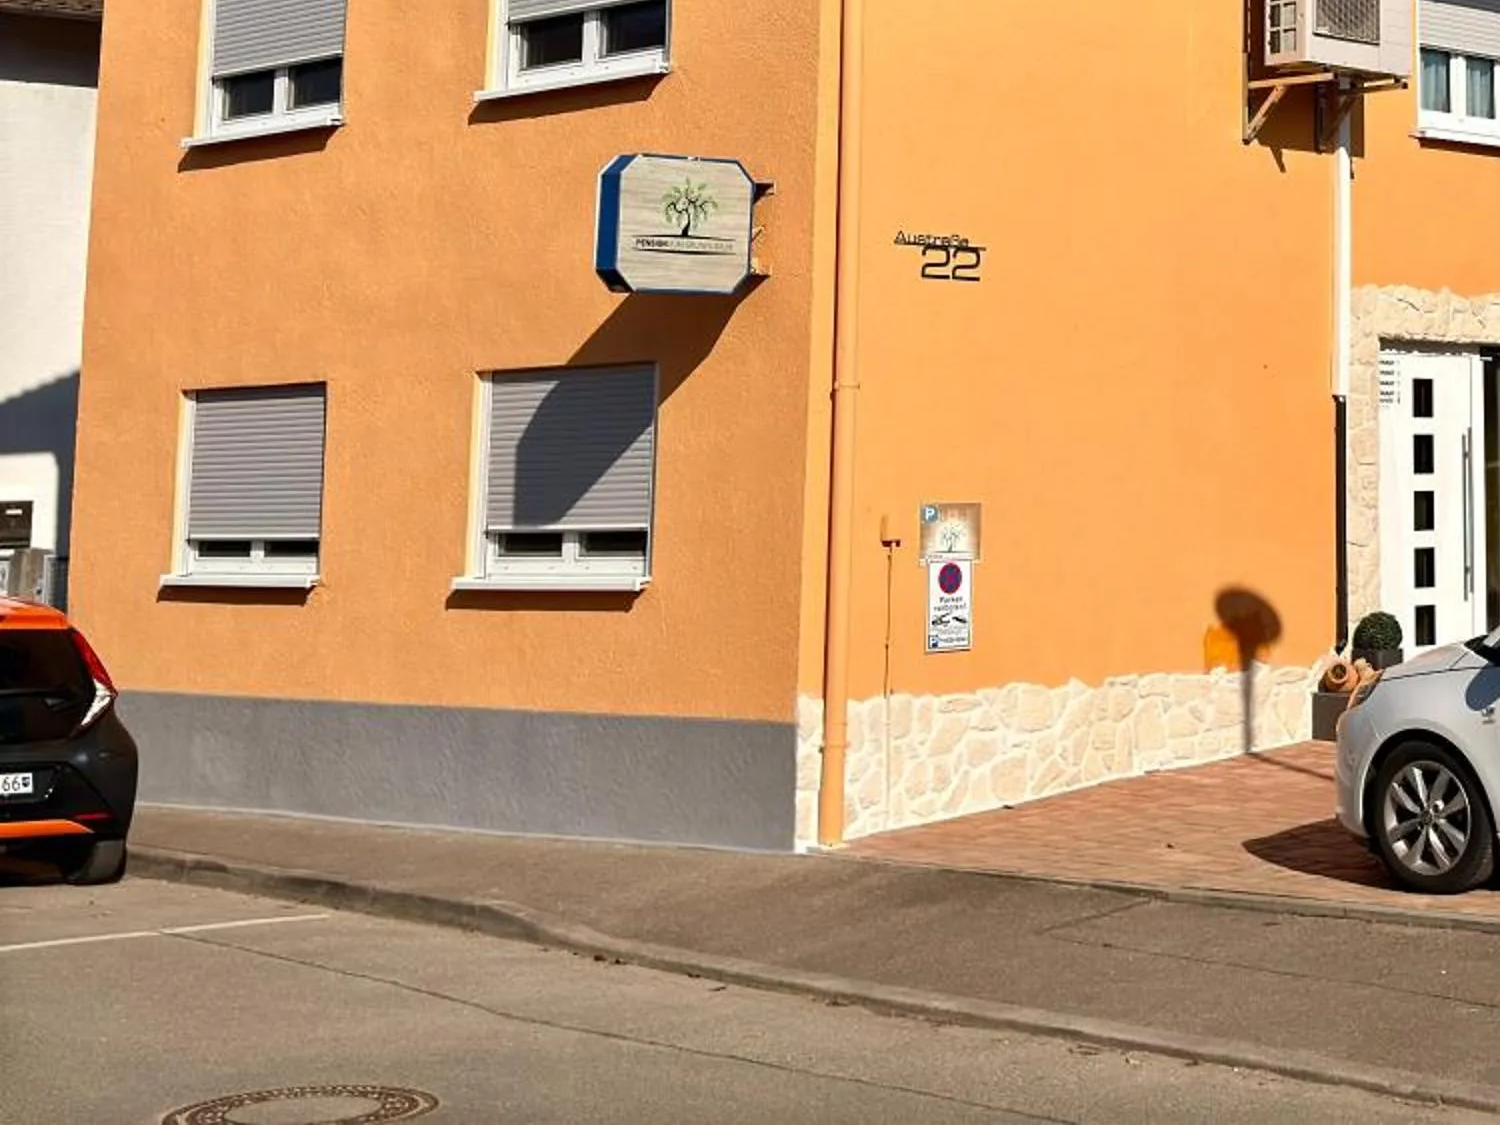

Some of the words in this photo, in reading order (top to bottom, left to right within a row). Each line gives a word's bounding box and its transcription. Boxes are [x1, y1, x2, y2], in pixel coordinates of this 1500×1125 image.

[921, 246, 981, 281] 22
[925, 507, 935, 520] P
[1, 776, 21, 792] 66
